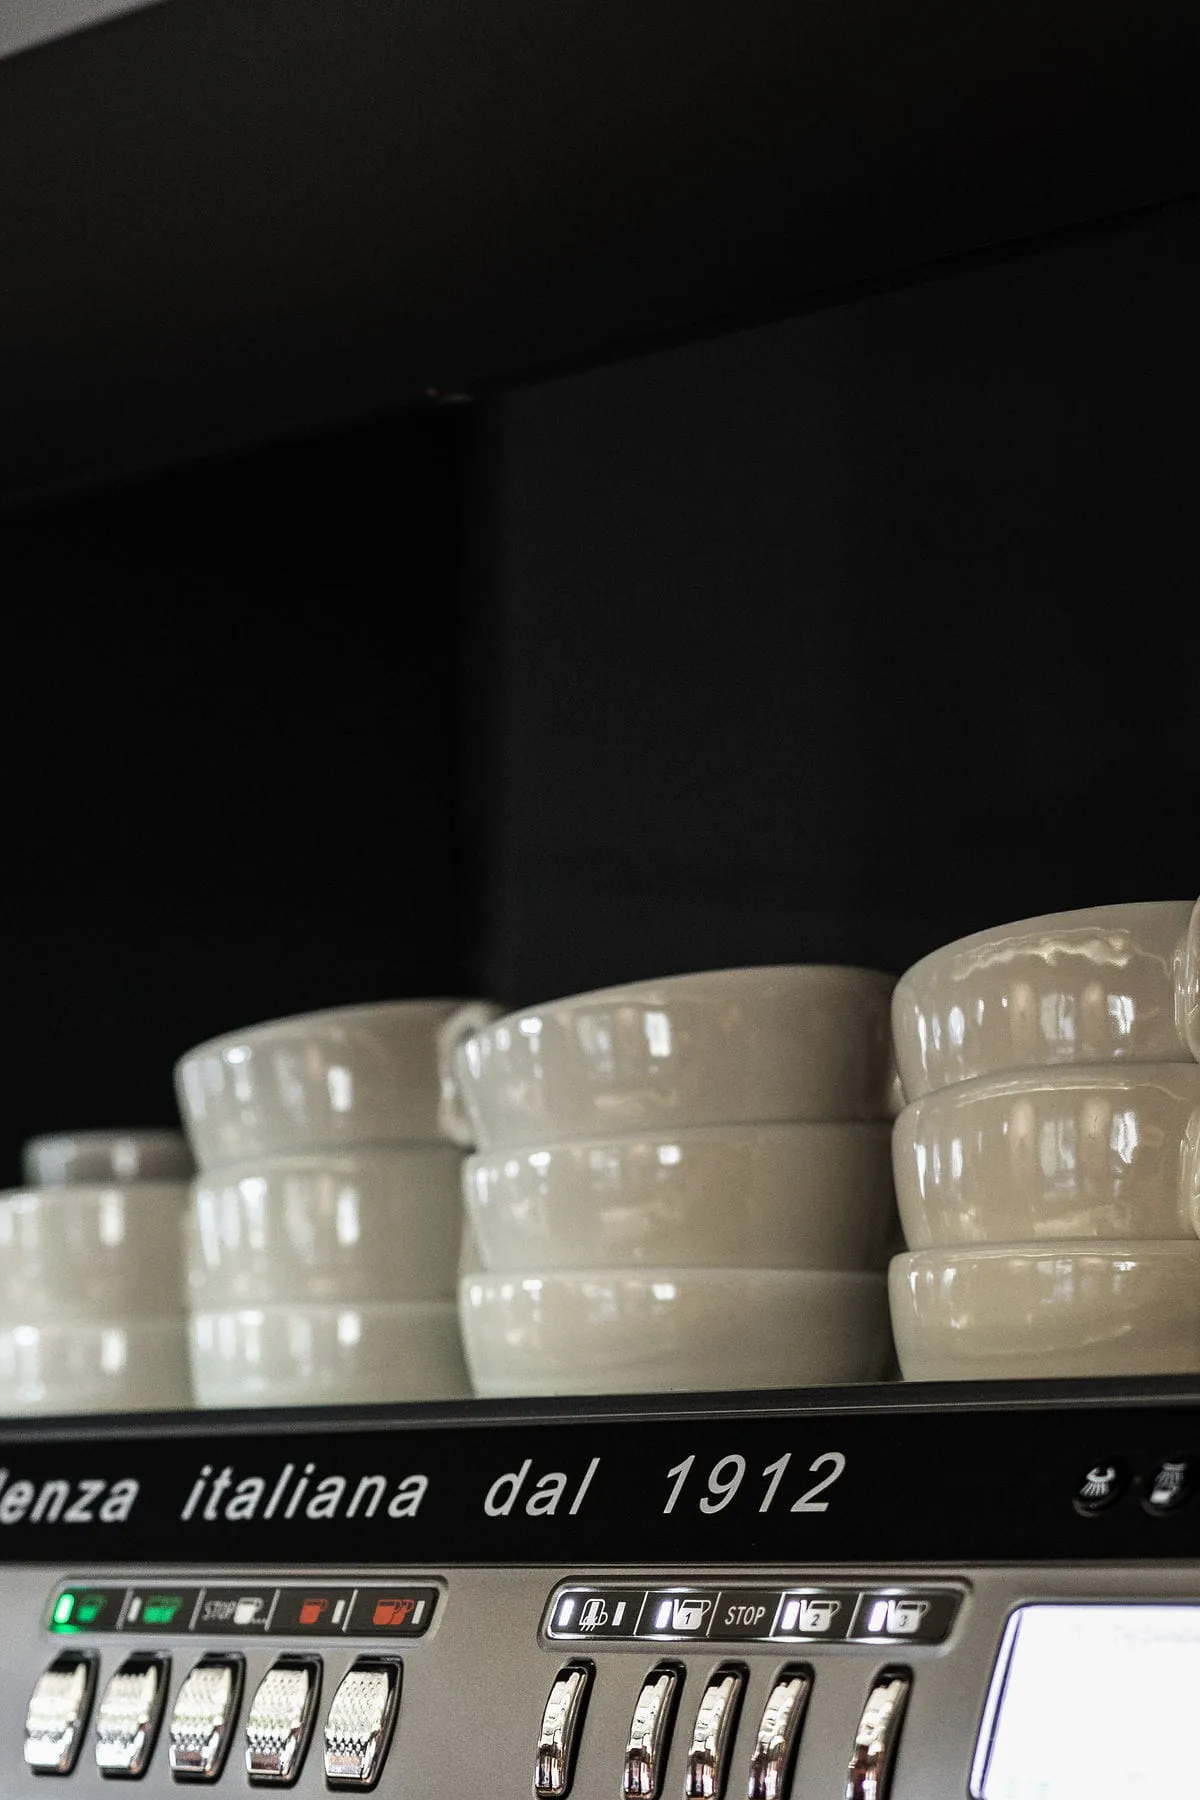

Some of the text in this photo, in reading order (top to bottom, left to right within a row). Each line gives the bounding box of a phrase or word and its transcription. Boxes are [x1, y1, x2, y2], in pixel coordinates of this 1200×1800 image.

[180, 1463, 430, 1521] italiana
[483, 1457, 601, 1517] dal
[662, 1451, 847, 1515] 1912
[684, 1612, 692, 1625] 1
[724, 1606, 766, 1626] STOP
[811, 1613, 820, 1626] 2
